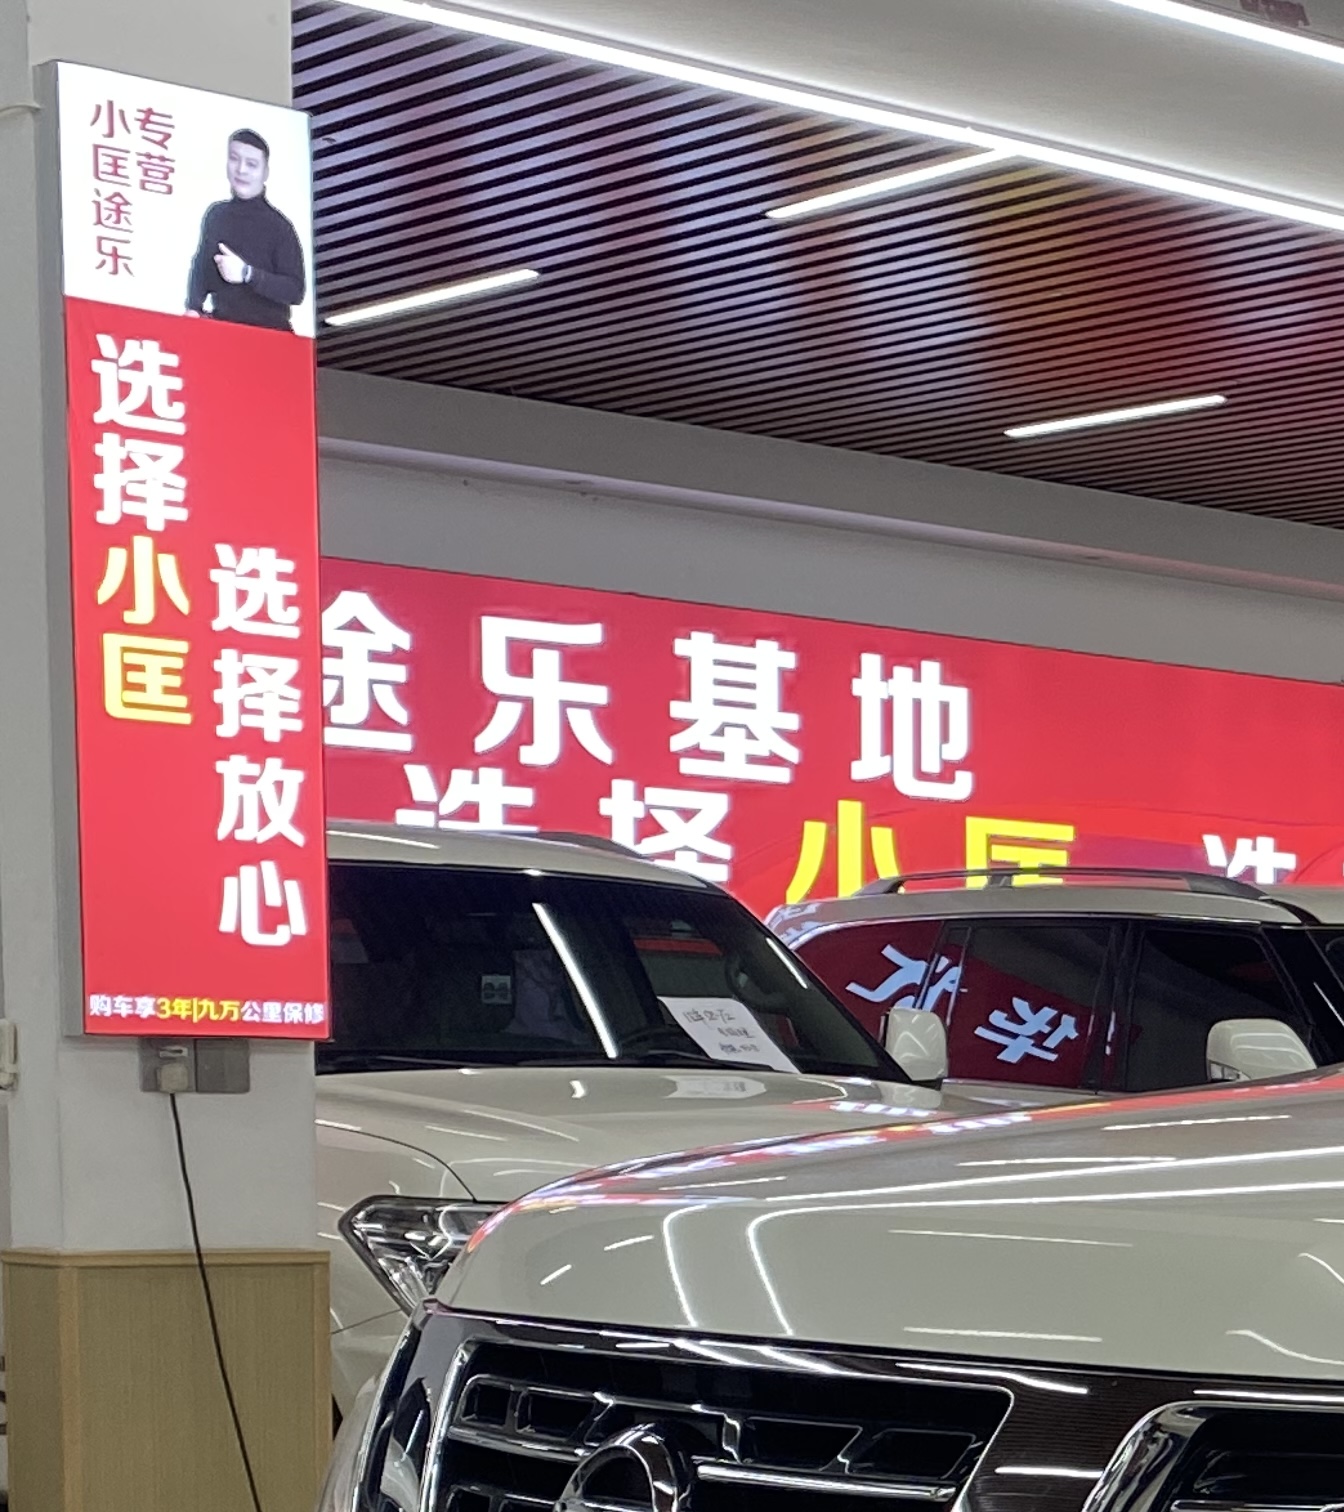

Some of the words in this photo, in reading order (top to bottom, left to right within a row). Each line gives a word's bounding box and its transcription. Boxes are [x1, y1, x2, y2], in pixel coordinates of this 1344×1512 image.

[90, 100, 134, 277] 小匡途乐
[134, 107, 175, 195] 专营
[91, 333, 192, 725] 选择小匡
[210, 543, 308, 946] 选择放心
